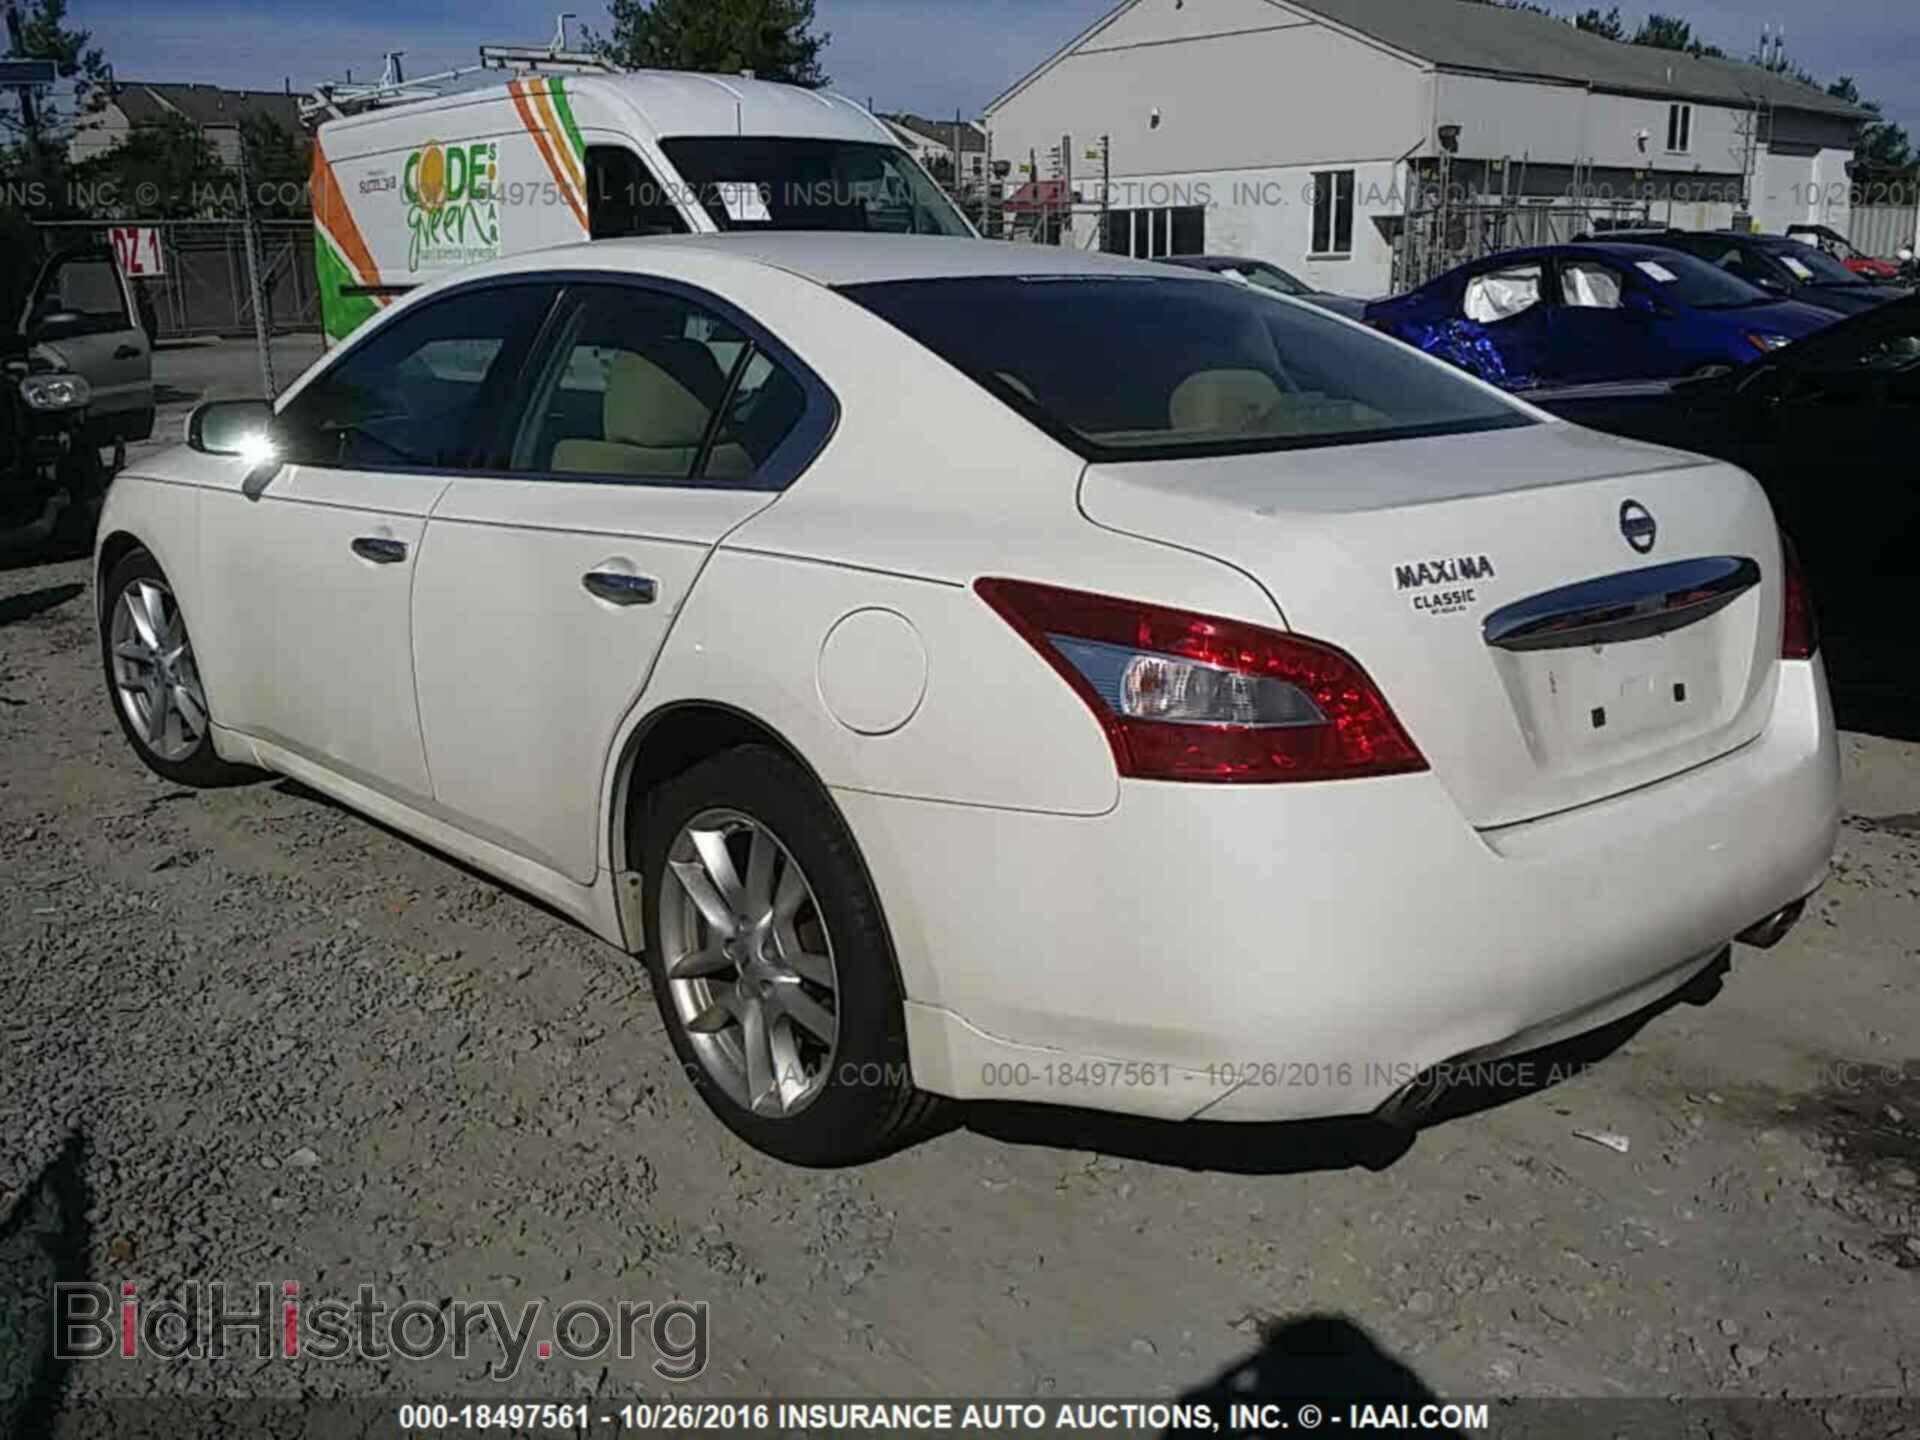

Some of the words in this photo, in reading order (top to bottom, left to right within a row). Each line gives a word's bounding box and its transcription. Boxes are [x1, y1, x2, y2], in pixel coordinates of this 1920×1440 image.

[404, 141, 488, 208] CODE
[408, 202, 493, 273] green
[1413, 588, 1476, 610] CLASSIC
